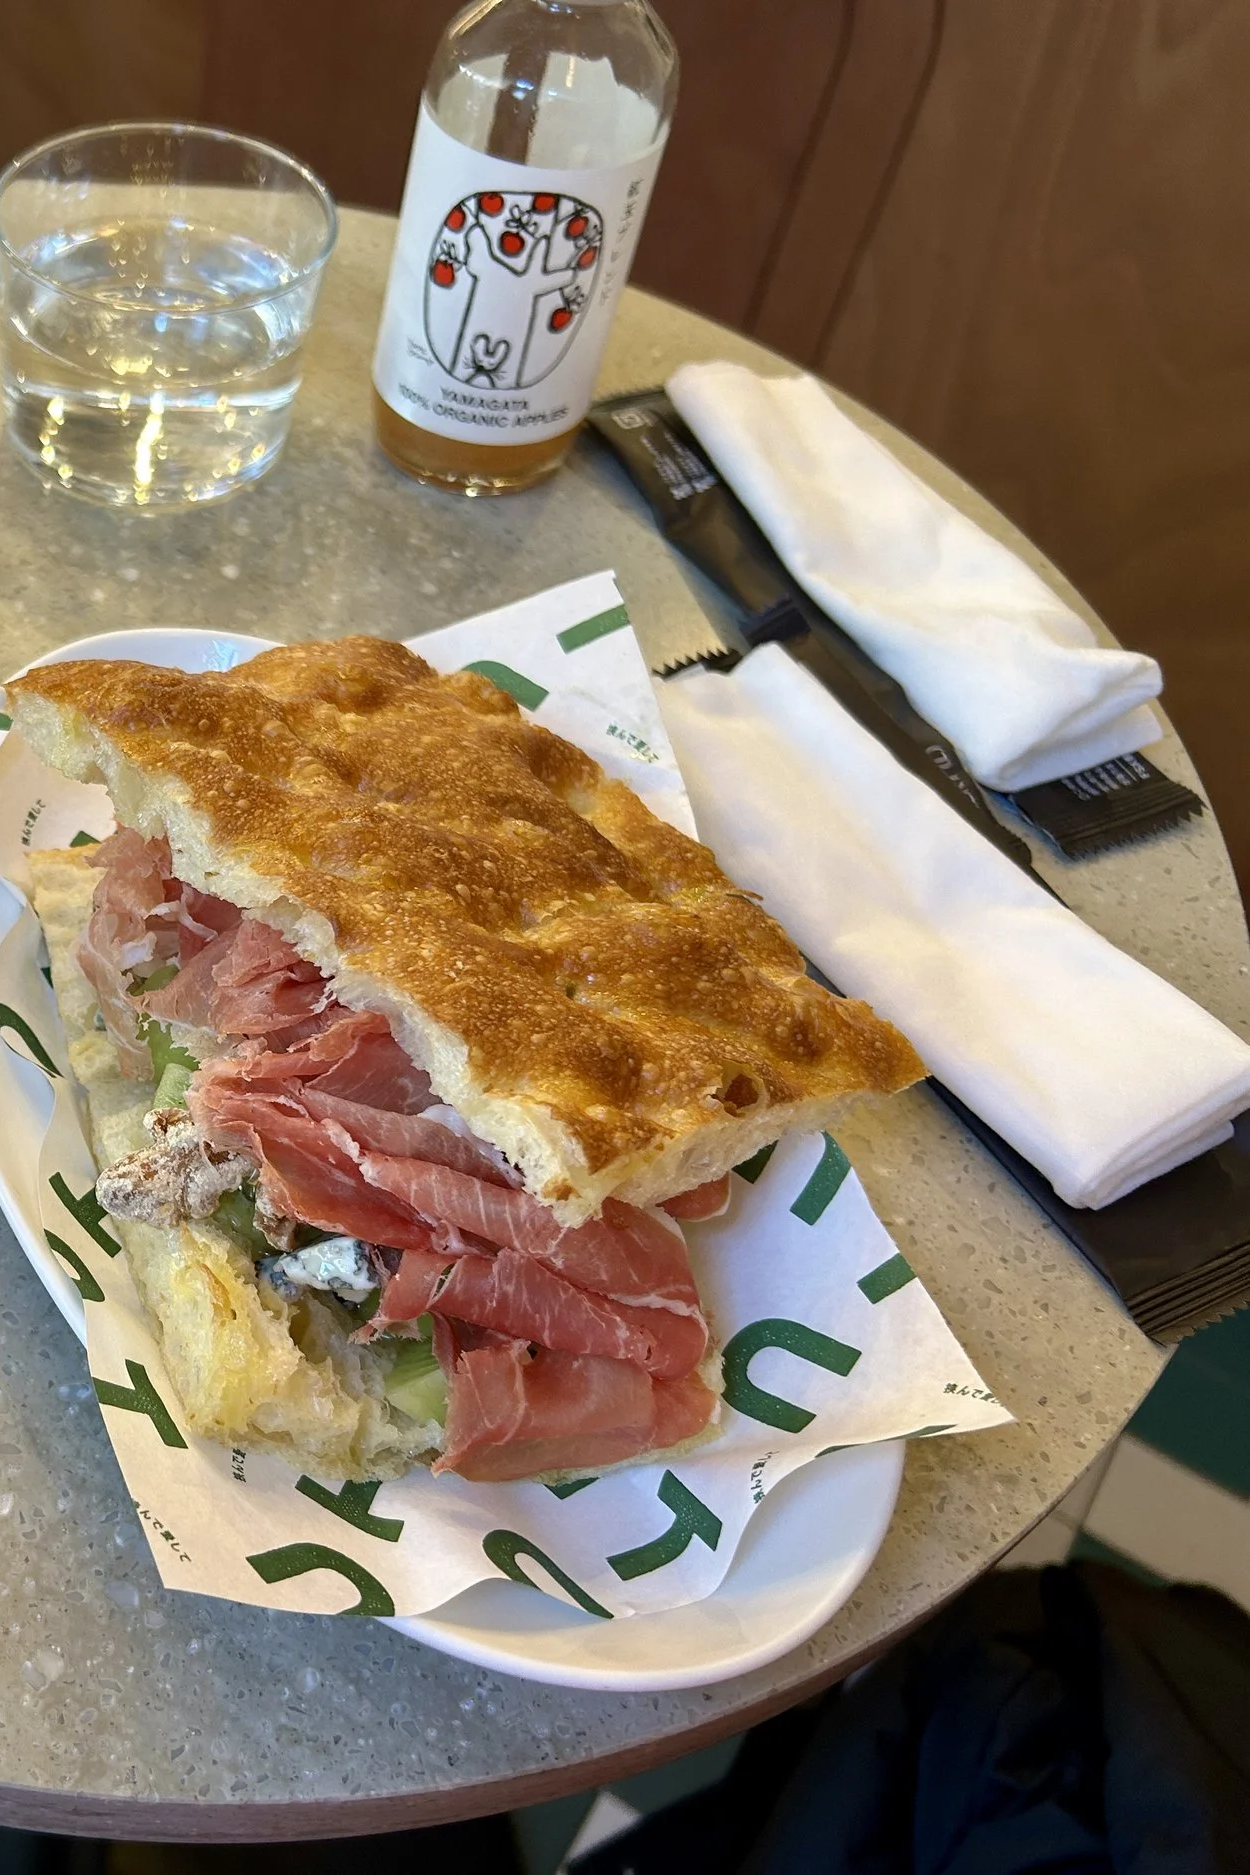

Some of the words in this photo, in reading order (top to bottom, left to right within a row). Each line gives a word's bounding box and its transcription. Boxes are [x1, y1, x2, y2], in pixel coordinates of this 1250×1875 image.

[432, 402, 508, 428] ORGANIC
[512, 404, 570, 427] APPLES
[441, 386, 529, 411] YAMAGATA
[722, 1317, 862, 1433] U
[133, 1503, 191, 1563] んで愛して
